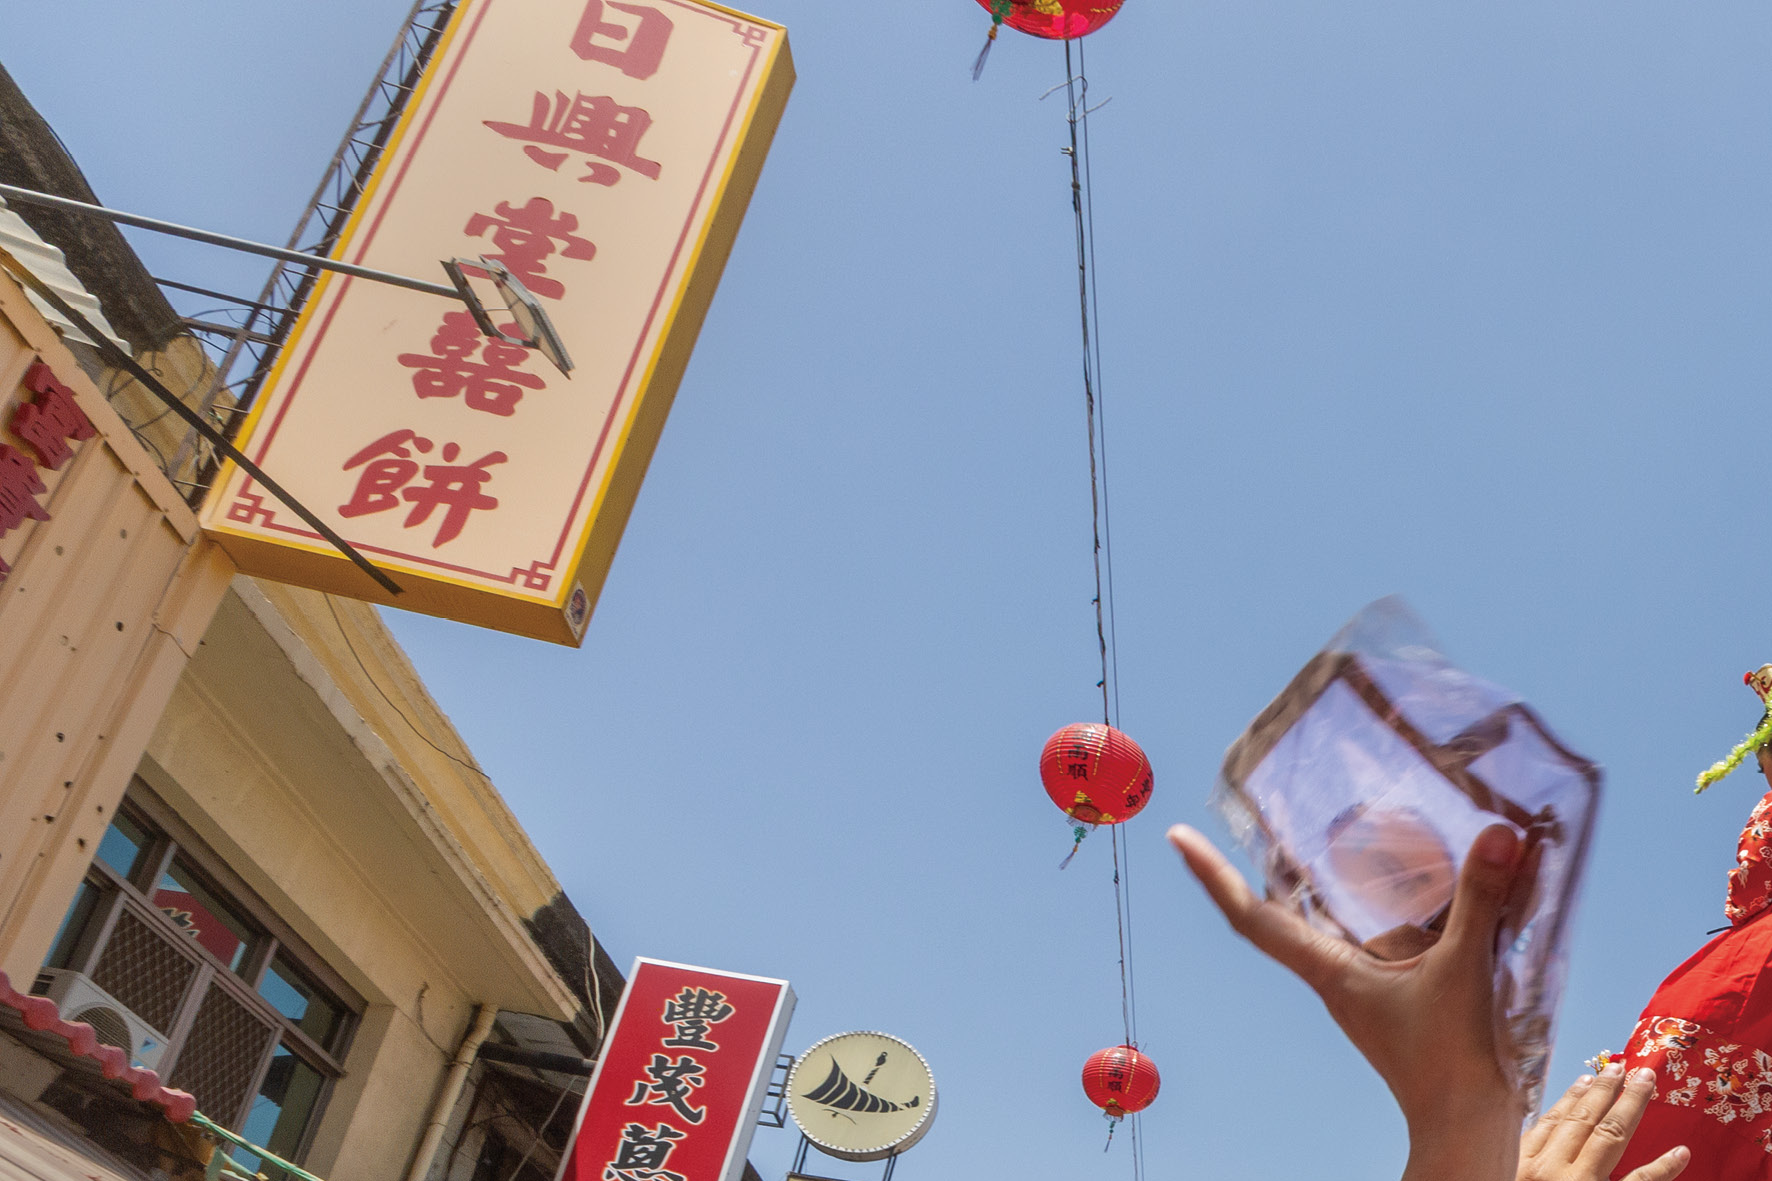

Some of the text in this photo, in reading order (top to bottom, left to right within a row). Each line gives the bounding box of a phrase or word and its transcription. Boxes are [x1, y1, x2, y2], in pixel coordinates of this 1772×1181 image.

[338, 0, 674, 548] 日興堂囍餅
